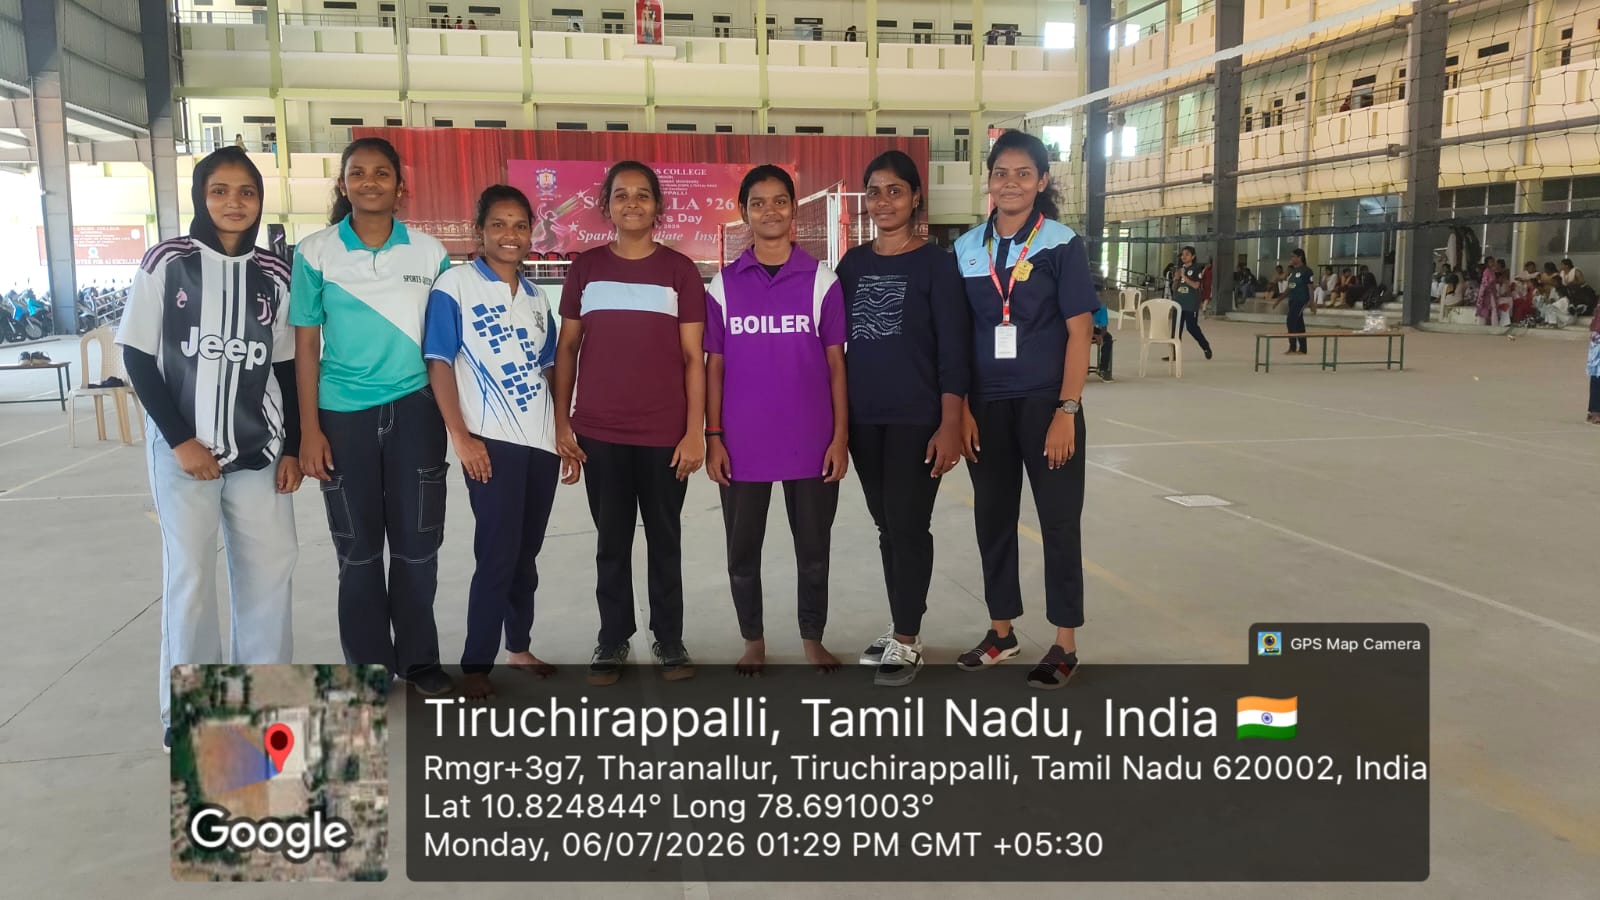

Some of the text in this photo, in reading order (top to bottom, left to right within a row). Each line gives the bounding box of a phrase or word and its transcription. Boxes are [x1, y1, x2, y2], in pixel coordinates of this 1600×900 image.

[663, 168, 707, 176] COLLEGE
[677, 213, 702, 224] Day
[577, 230, 617, 243] Spark
[652, 230, 683, 241] diate
[403, 274, 421, 284] SPORTS
[730, 314, 810, 335] BOILER
[180, 326, 267, 370] Jeep
